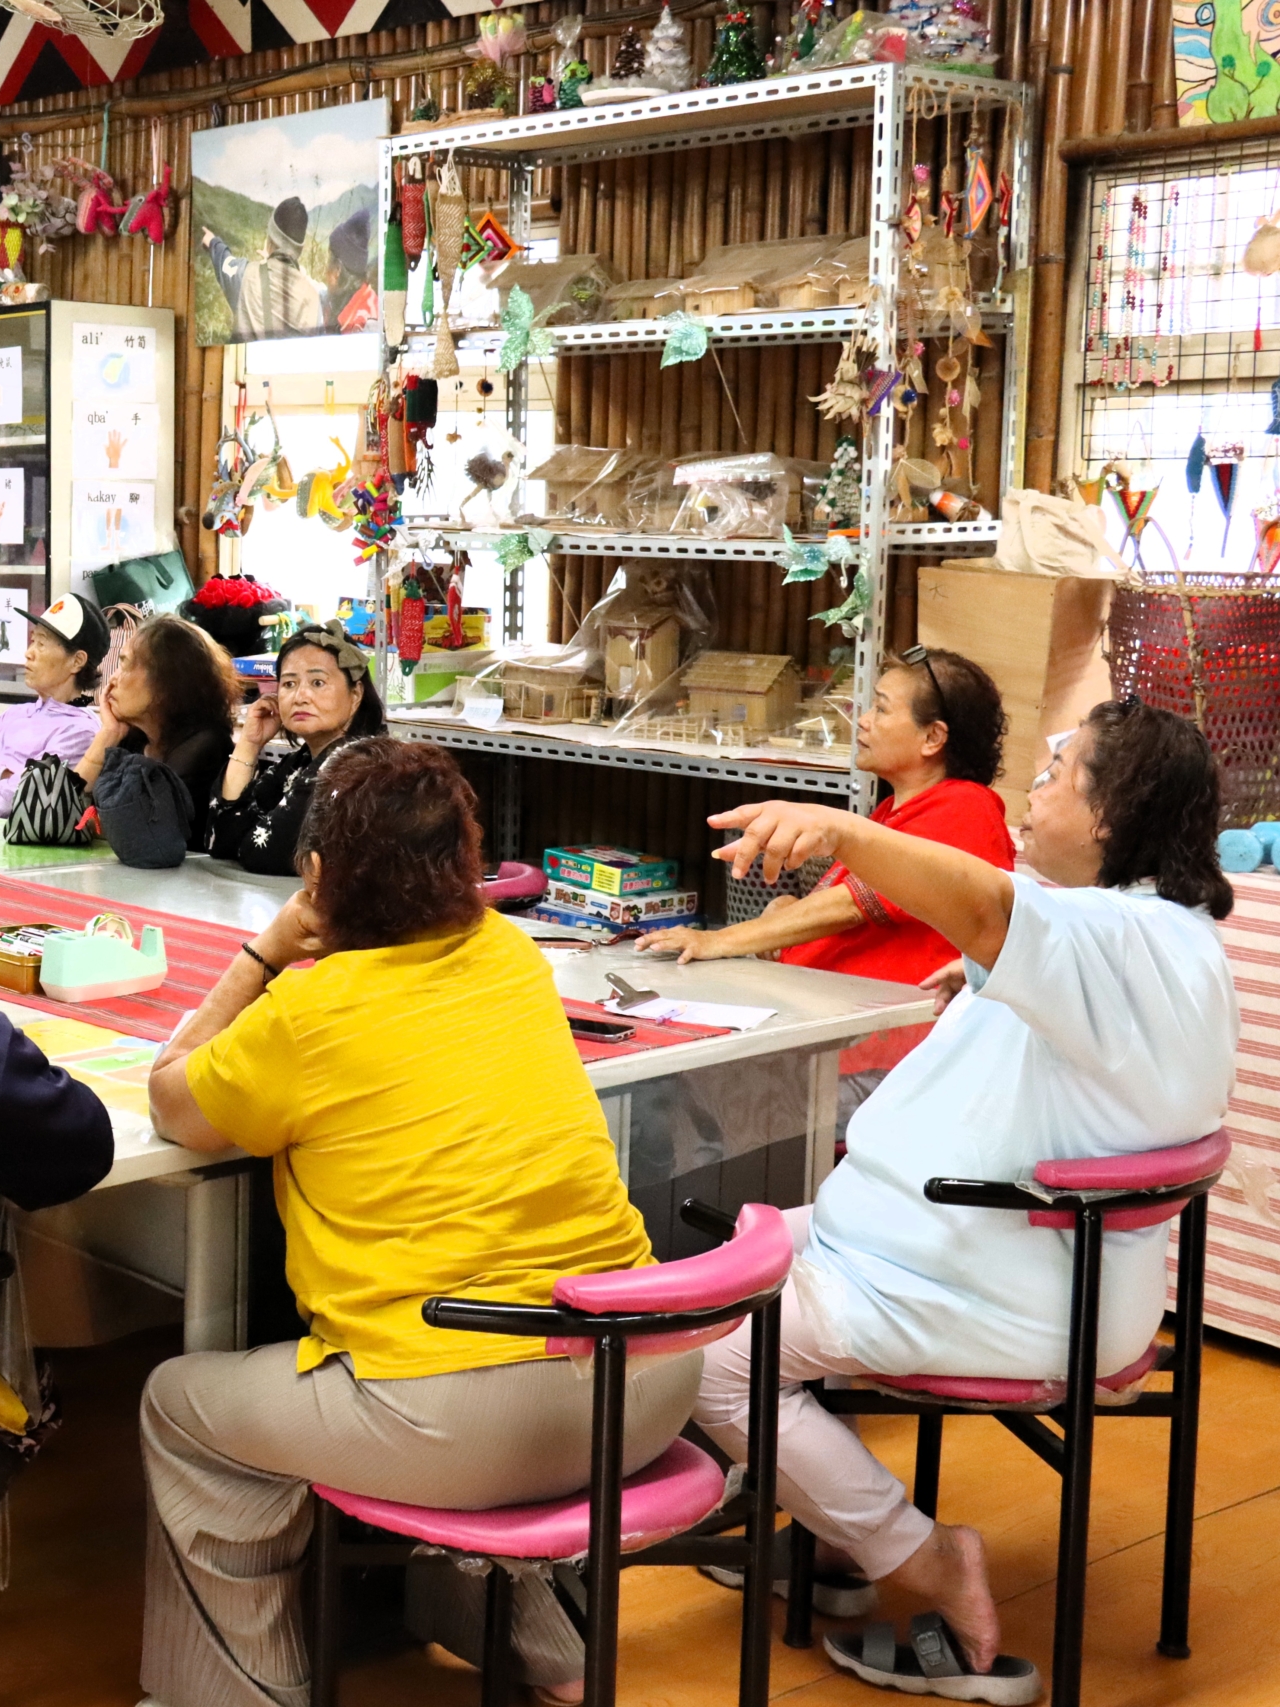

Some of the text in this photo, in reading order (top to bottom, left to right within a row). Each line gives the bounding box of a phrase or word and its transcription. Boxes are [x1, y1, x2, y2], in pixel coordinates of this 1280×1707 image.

[125, 335, 146, 349] 竹筍
[131, 412, 142, 426] 手
[4, 597, 13, 612] 羊
